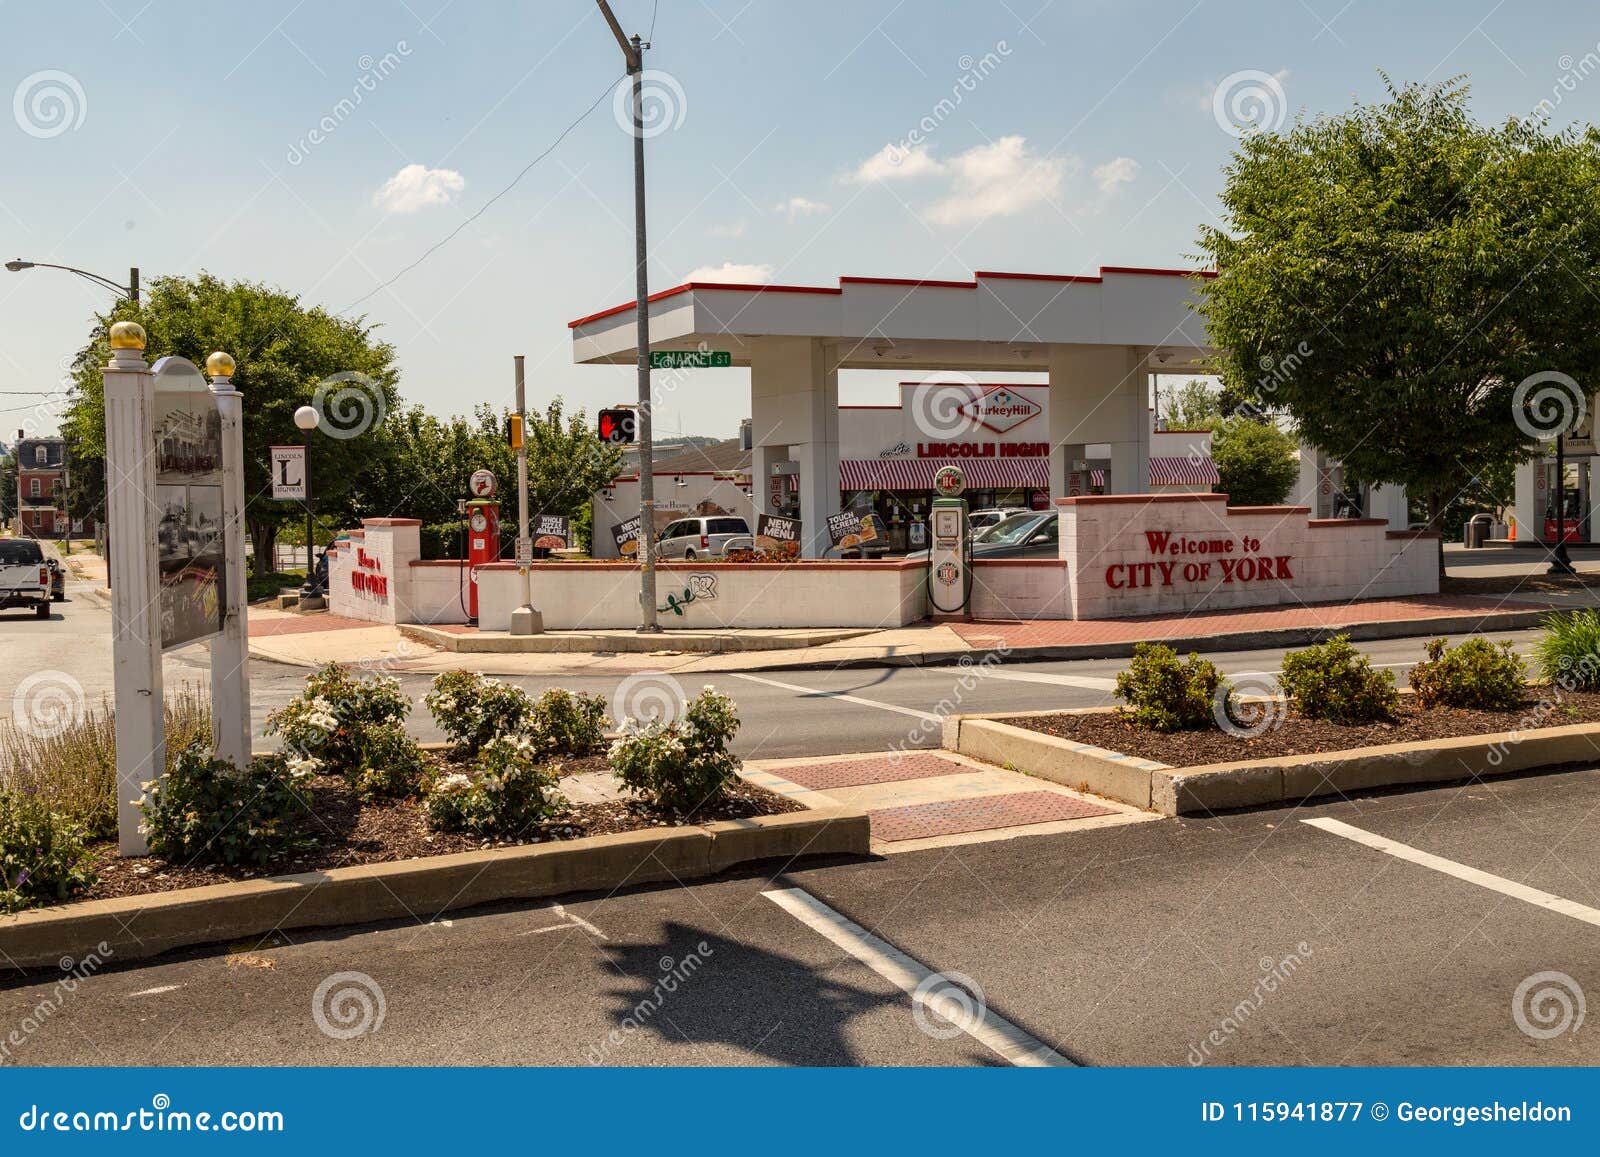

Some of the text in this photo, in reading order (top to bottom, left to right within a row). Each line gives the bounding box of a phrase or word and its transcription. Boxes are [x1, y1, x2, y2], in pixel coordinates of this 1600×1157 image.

[653, 352, 728, 365] E MARKET ST
[917, 443, 996, 458] LINCOLN
[277, 460, 301, 486] L
[621, 518, 640, 532] NEW
[767, 518, 793, 530] NEW
[828, 512, 855, 524] TOUCH
[830, 517, 860, 531] SCREEN
[763, 526, 795, 540] MENU
[1144, 531, 1261, 555] Welcome to
[1105, 556, 1295, 589] CITY OF YORK
